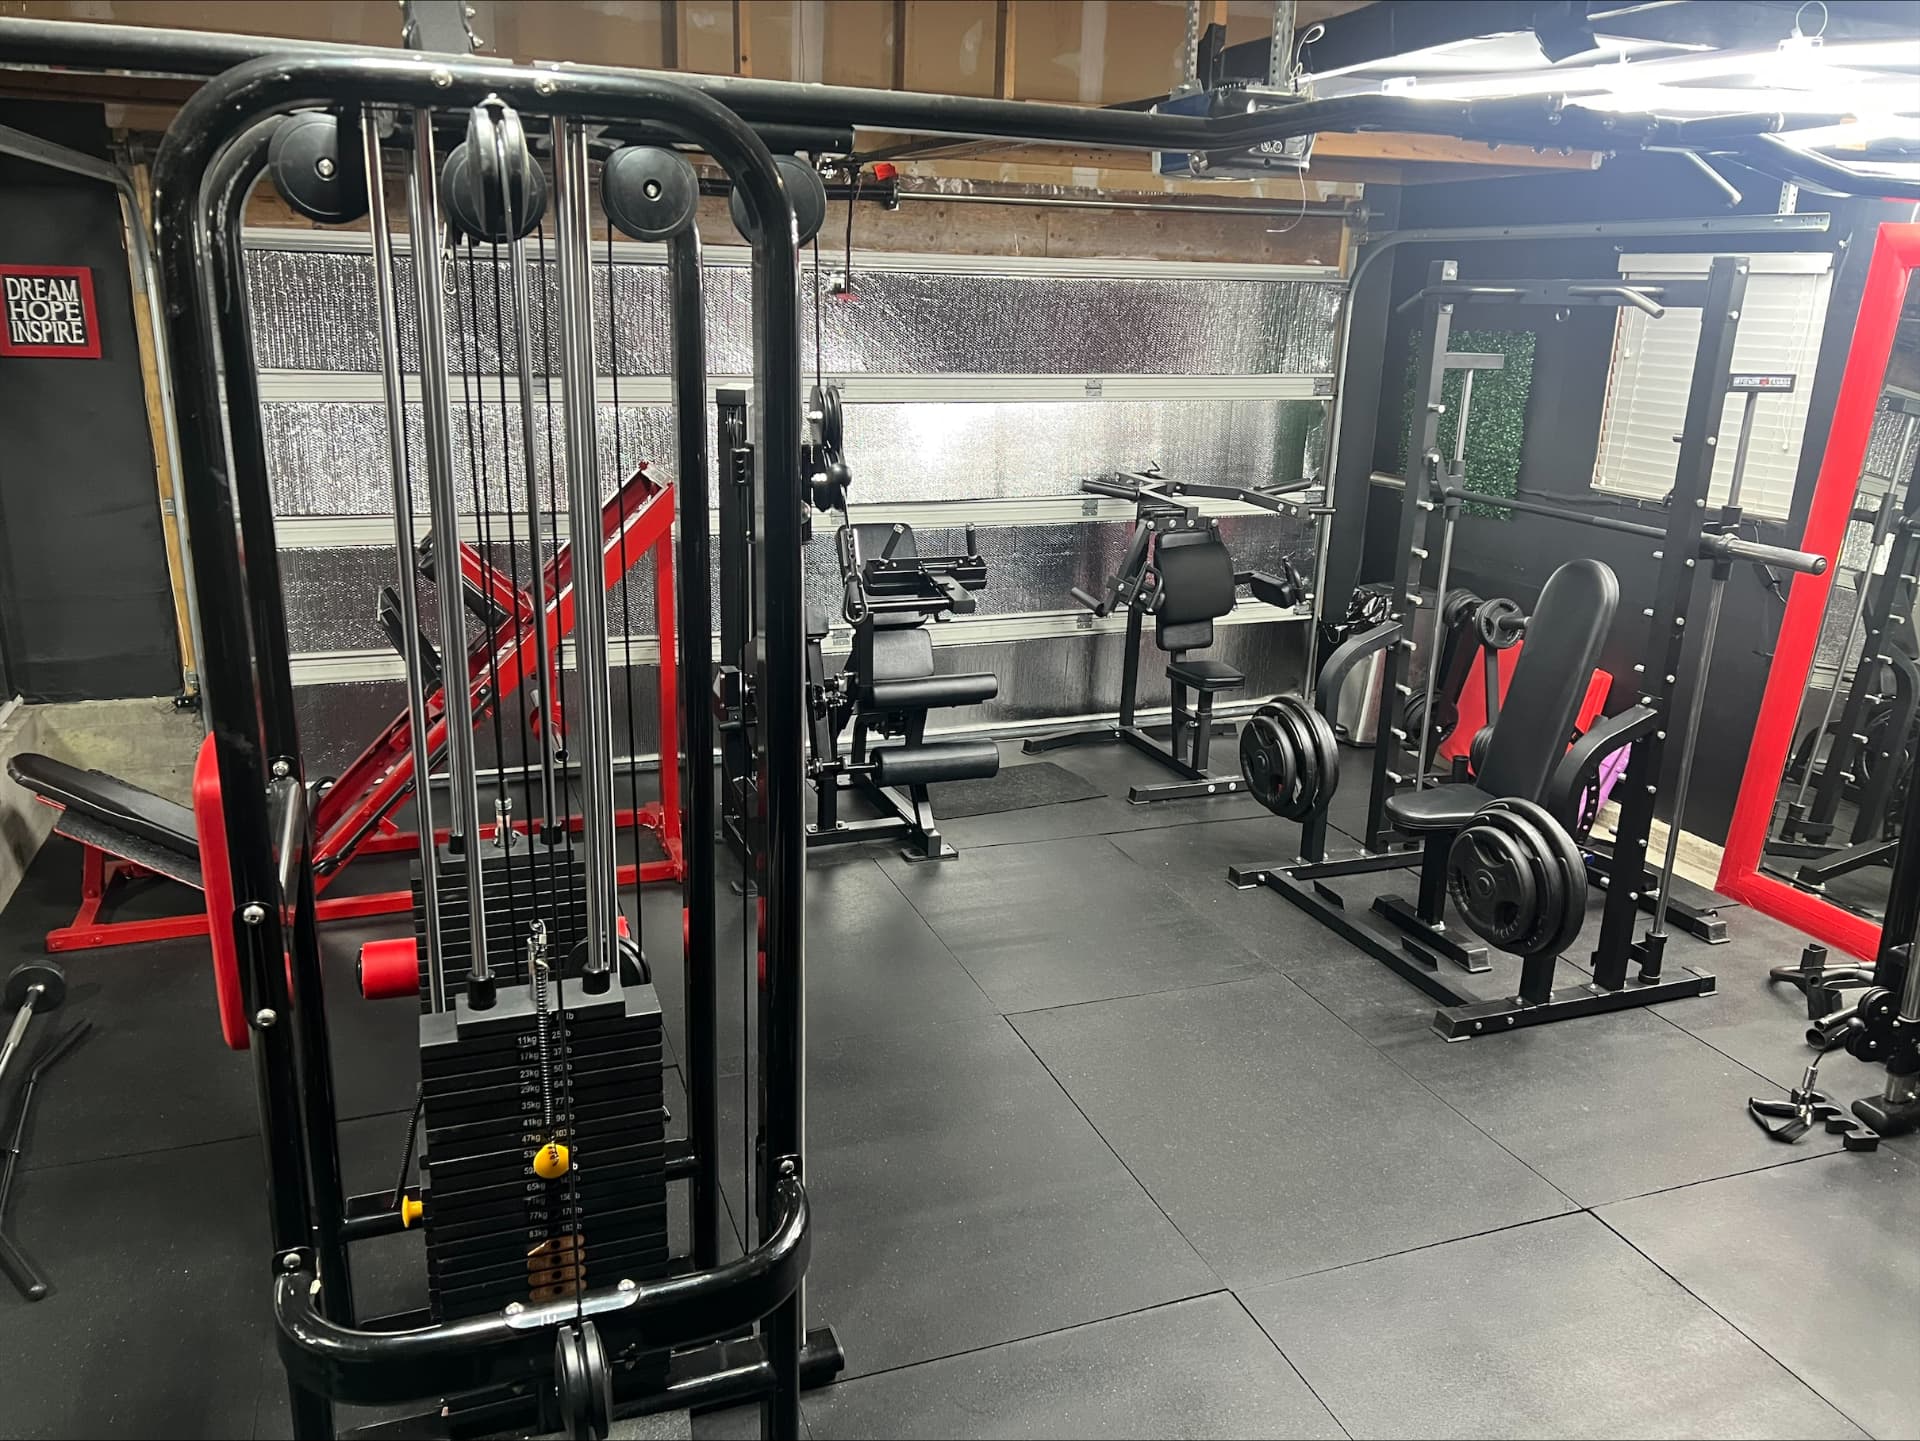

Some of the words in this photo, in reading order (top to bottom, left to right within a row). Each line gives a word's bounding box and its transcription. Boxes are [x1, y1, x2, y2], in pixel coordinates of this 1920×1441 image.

[5, 278, 79, 302] DREAM
[8, 300, 82, 321] HOPE
[11, 320, 85, 344] INSPIRE
[517, 1035, 537, 1046] 11kg
[551, 1029, 571, 1040] 25b
[553, 1046, 573, 1056] 37b
[519, 1069, 540, 1079] 23kg
[553, 1063, 573, 1073] 50b
[553, 1079, 573, 1089] 64b
[521, 1101, 541, 1110] 35kg
[554, 1096, 574, 1105] 77b
[522, 1118, 543, 1127] 41kg
[555, 1112, 575, 1122] 90b
[521, 1134, 541, 1143] 47kg
[555, 1127, 576, 1137] 103b
